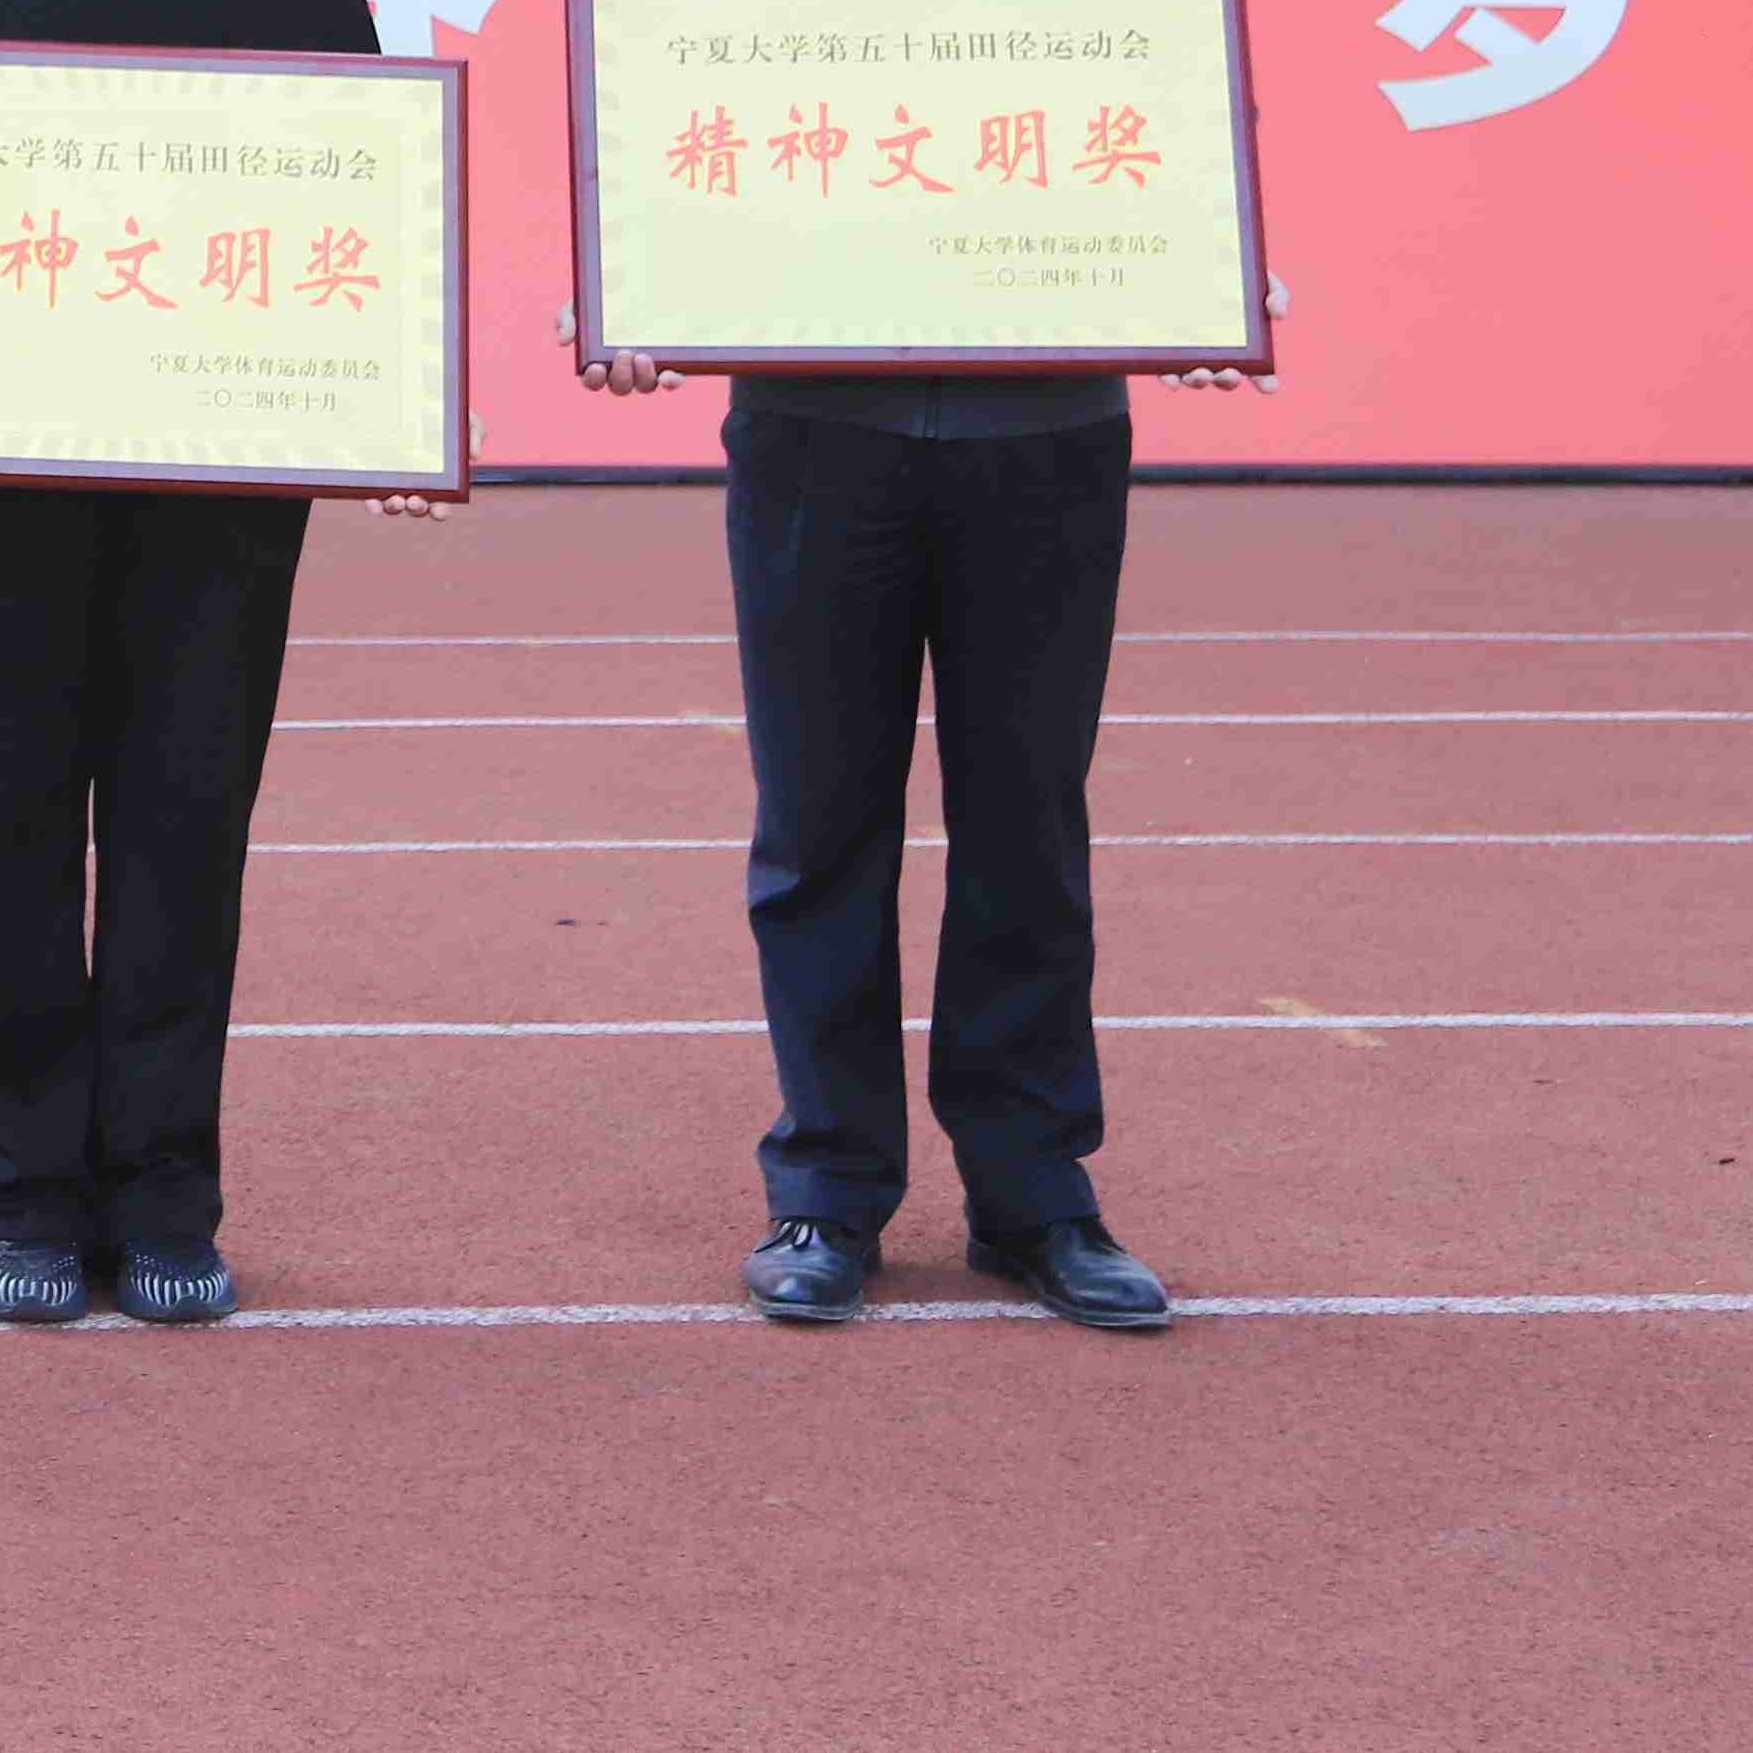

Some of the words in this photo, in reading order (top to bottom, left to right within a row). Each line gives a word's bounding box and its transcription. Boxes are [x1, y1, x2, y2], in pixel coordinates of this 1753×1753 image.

[667, 30, 1151, 65] 宁夏大学第五十届田径运动会
[666, 102, 1162, 198] 精神文明奖
